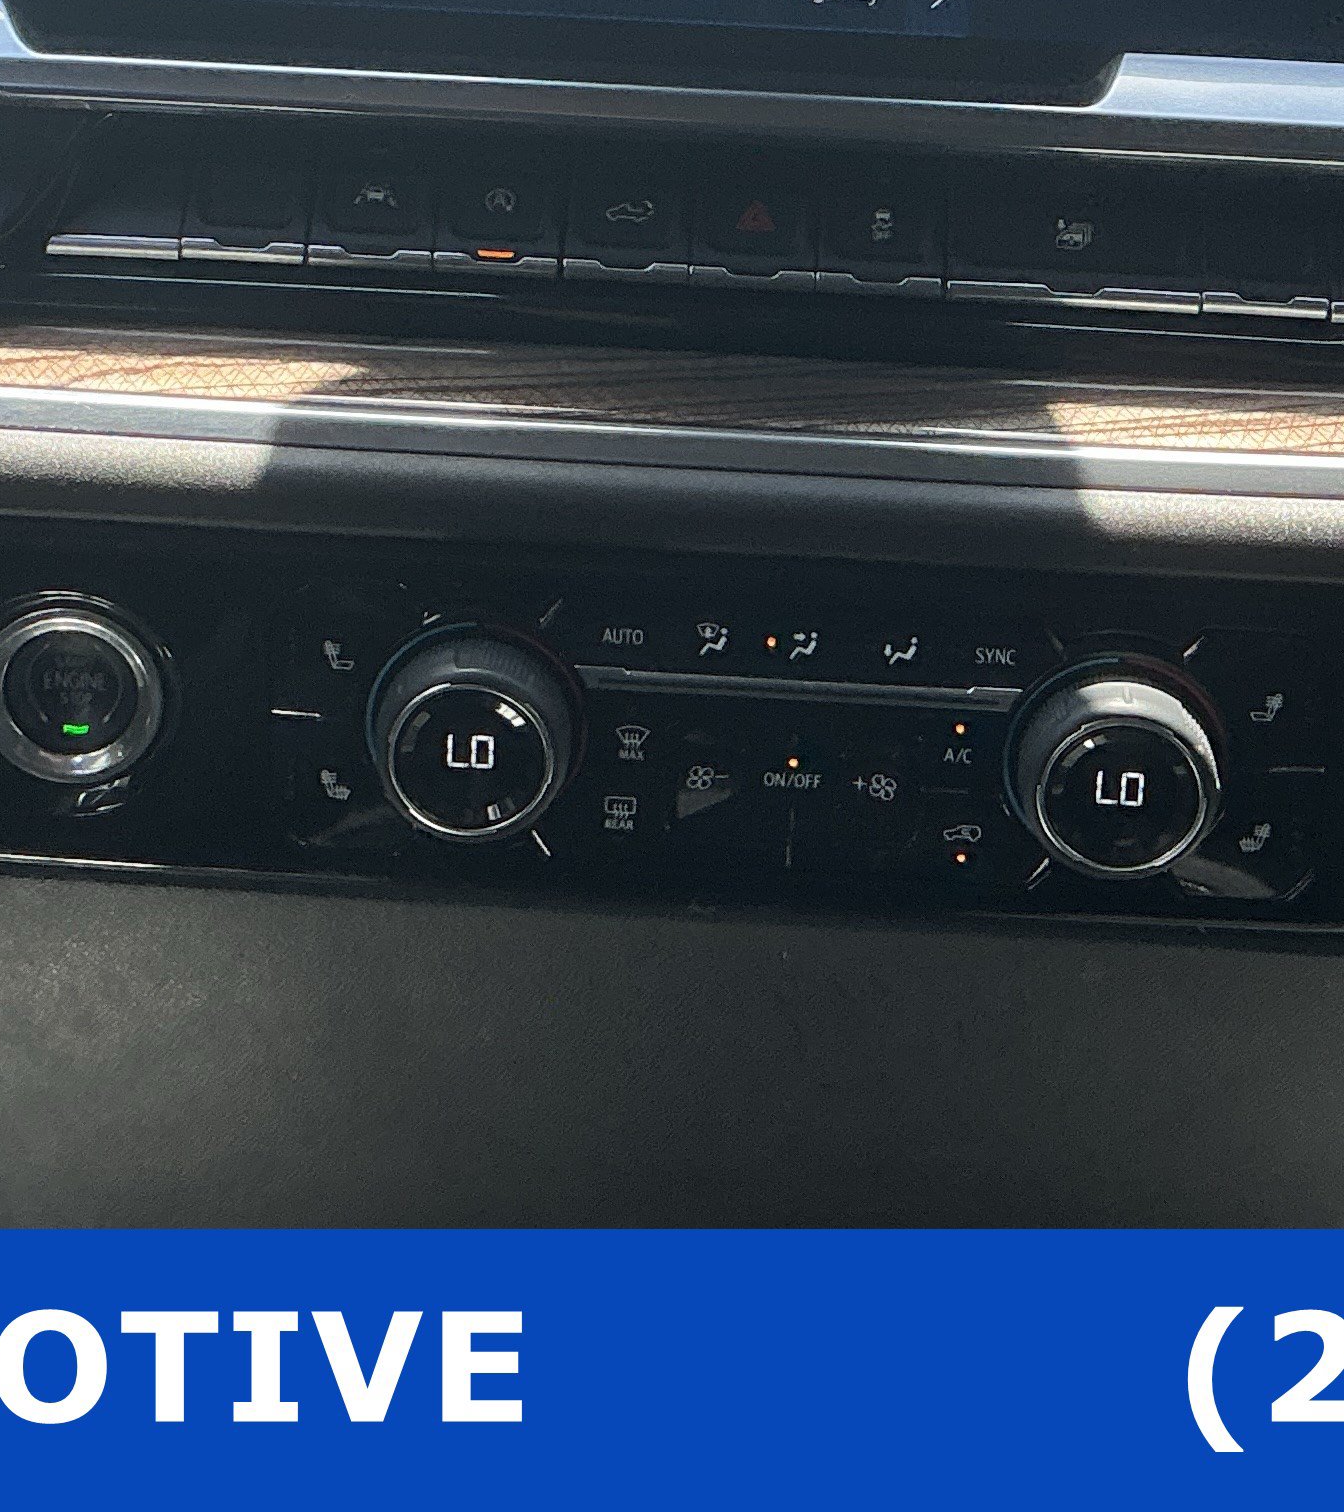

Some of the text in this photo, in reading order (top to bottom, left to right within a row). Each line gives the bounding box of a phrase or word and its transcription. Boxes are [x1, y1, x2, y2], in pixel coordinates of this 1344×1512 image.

[602, 627, 644, 645] AUTO
[975, 647, 1016, 666] SYNC
[618, 748, 645, 762] MAX
[943, 747, 972, 765] A/C
[763, 772, 821, 789] ON/OFF
[603, 818, 635, 831] REAR
